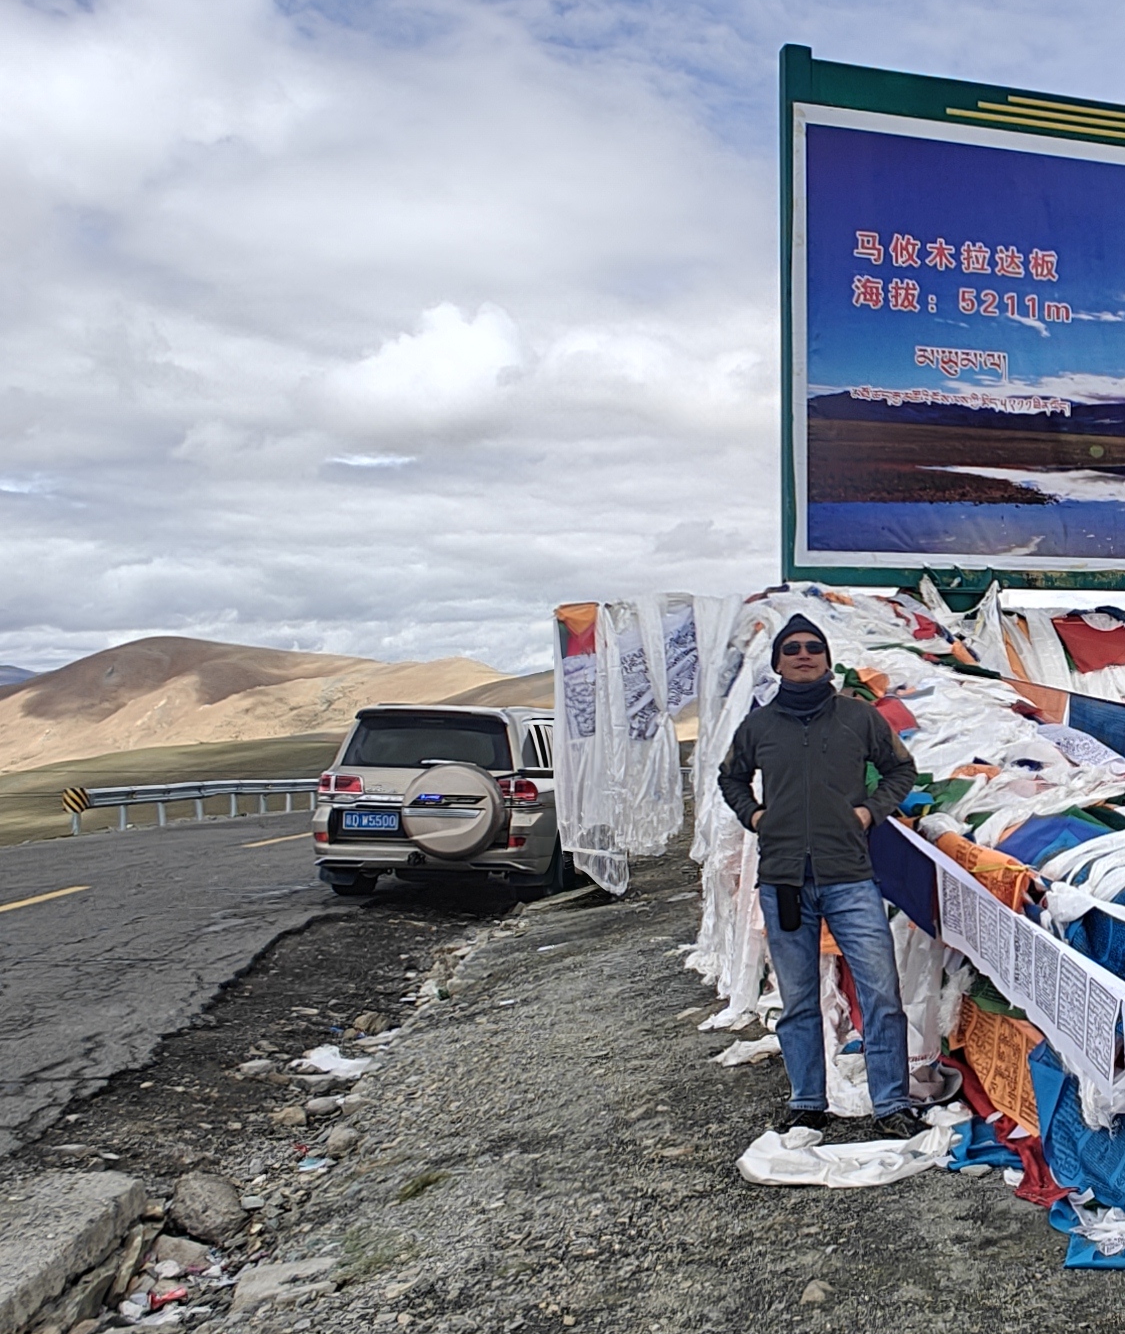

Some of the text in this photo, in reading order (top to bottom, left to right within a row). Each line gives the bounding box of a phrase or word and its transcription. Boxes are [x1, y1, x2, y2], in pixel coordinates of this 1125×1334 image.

[853, 230, 1058, 282] 马攸木拉达板
